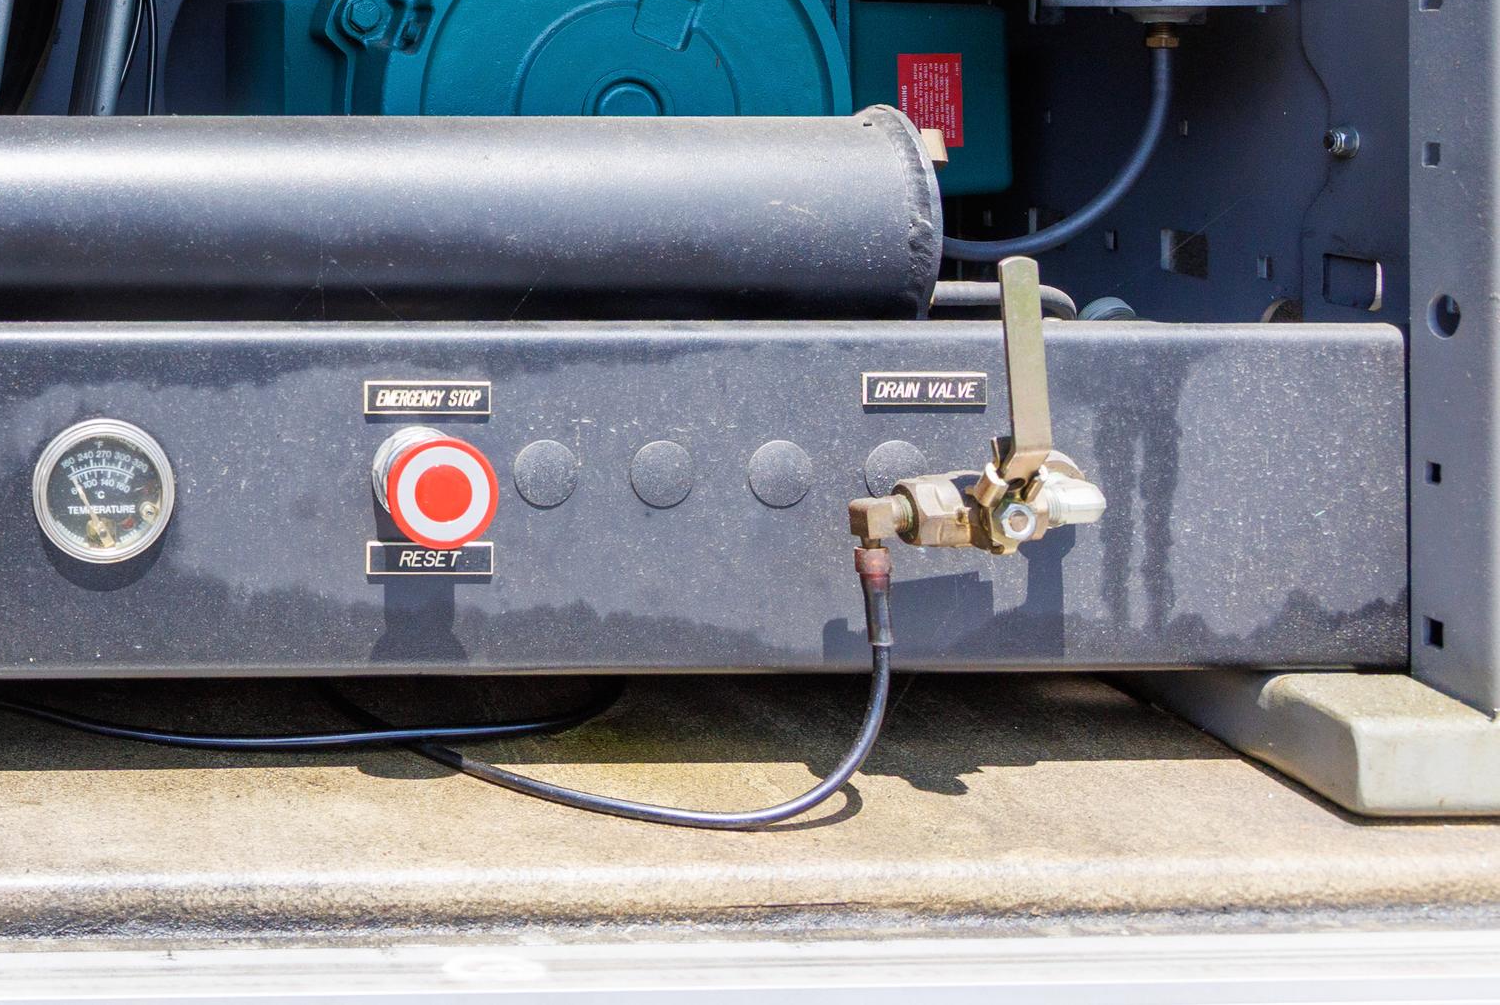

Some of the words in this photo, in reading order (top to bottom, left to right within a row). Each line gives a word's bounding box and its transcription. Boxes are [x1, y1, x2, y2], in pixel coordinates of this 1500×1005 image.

[875, 381, 920, 398] DRAIN
[928, 381, 978, 398] VALVE
[376, 389, 445, 407] EMERGENCY
[448, 390, 482, 407] STOP
[77, 451, 94, 461] 240
[114, 451, 131, 462] 300
[399, 551, 462, 567] RESET
